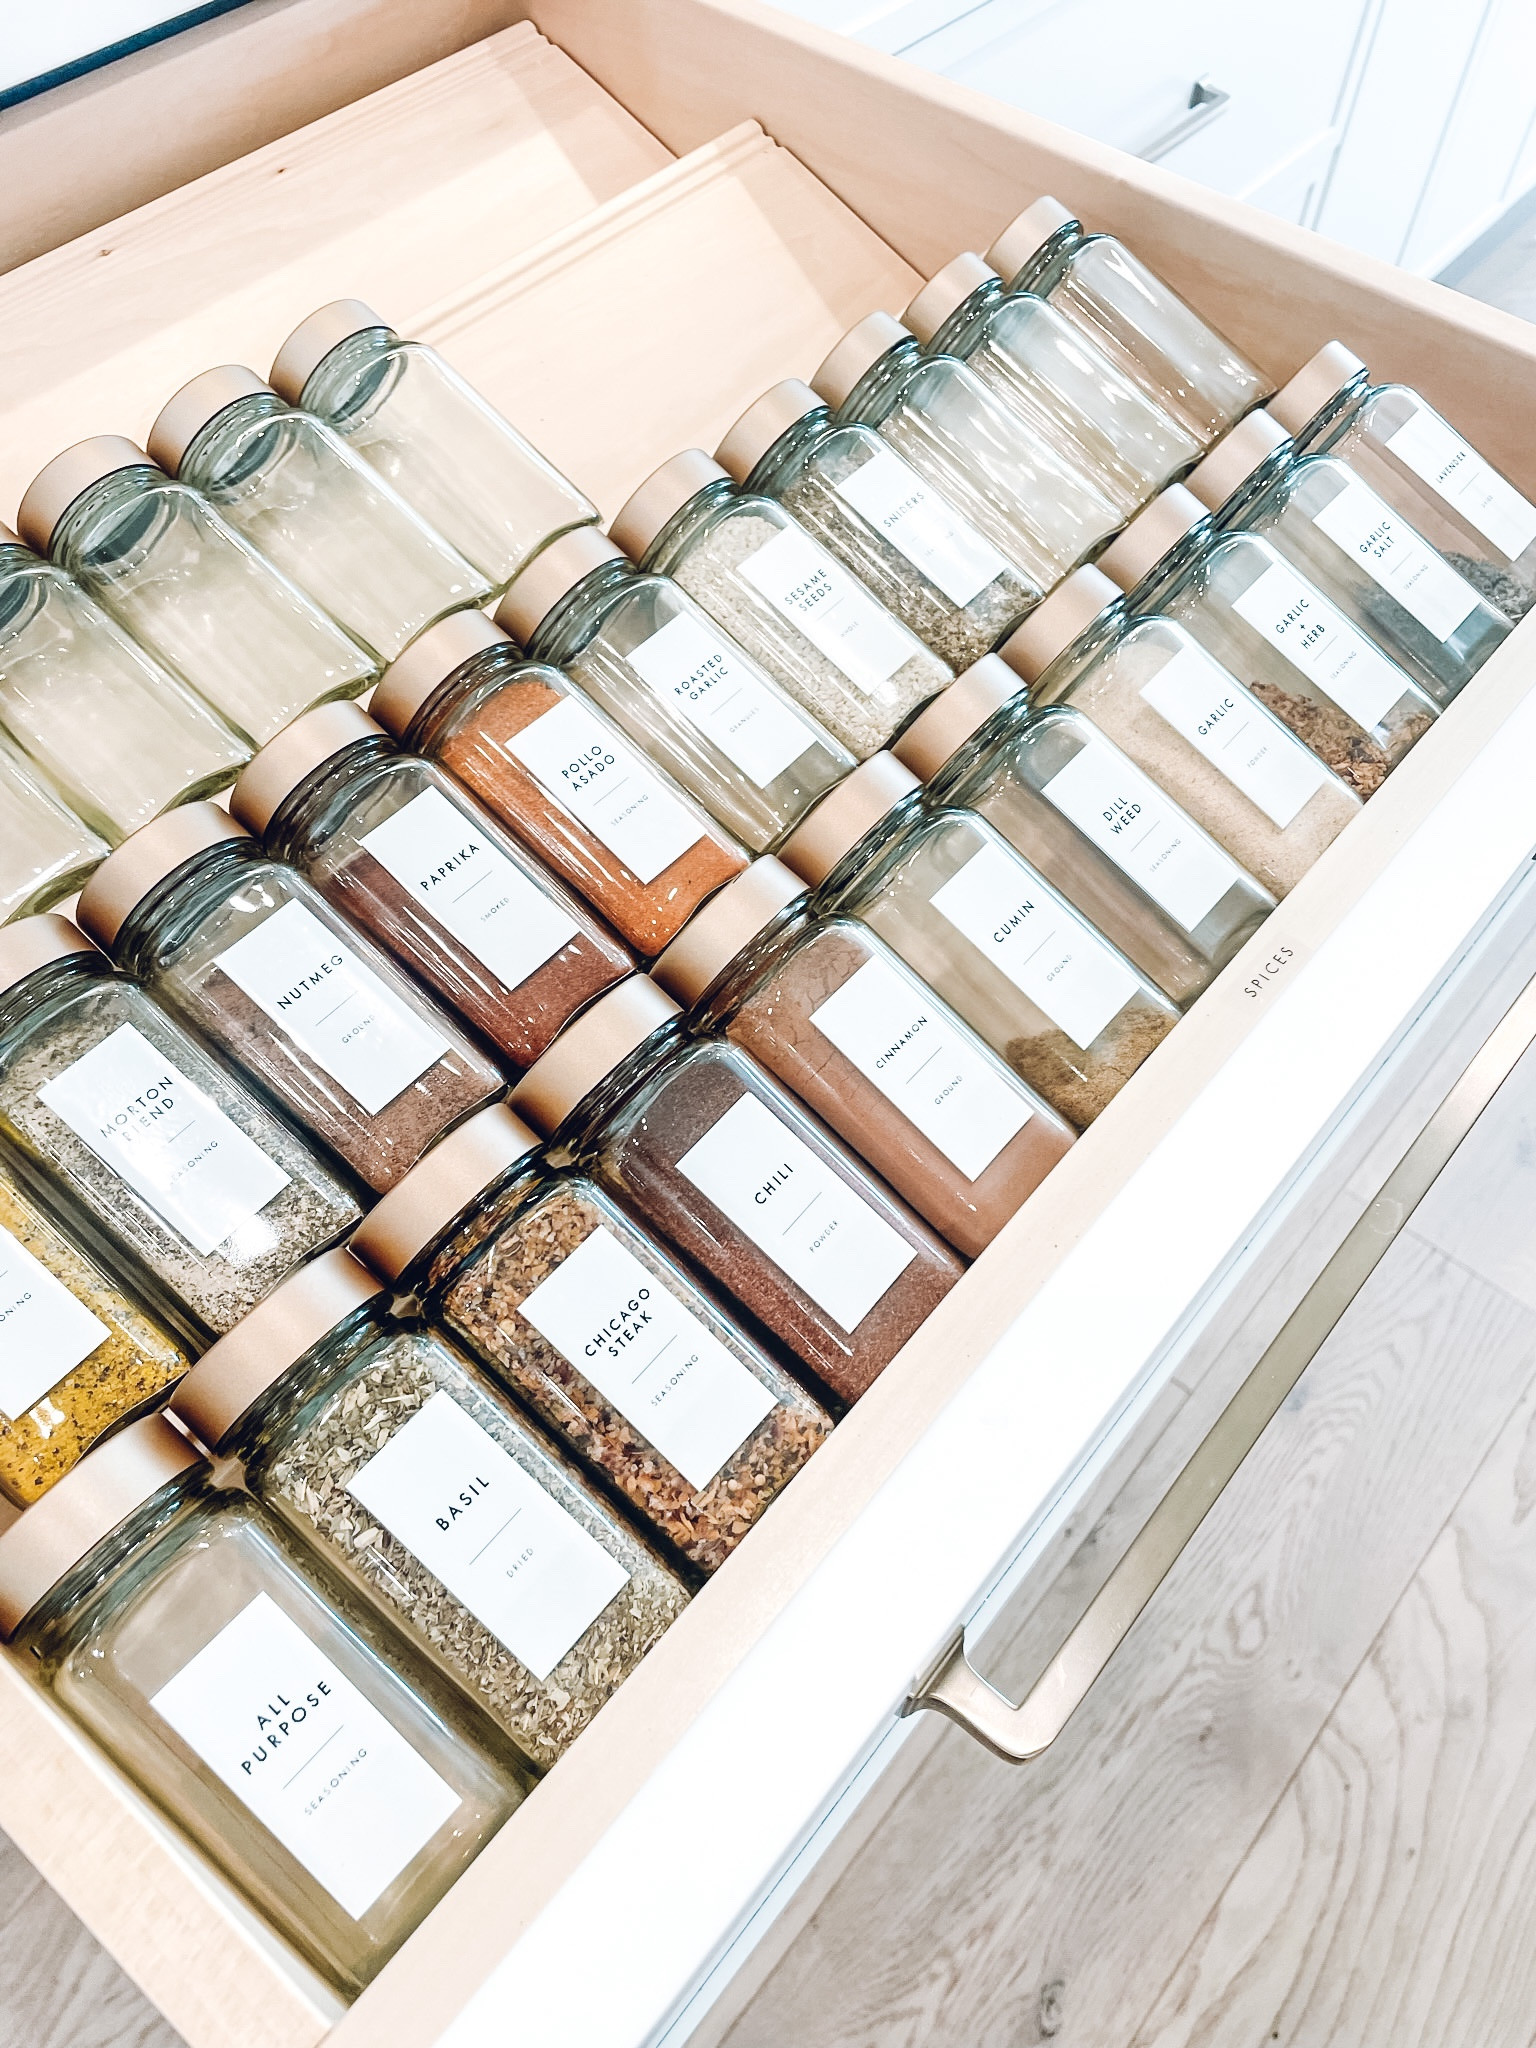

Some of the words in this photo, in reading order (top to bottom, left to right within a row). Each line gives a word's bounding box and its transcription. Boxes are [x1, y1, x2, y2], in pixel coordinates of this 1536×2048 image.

[1435, 451, 1467, 484] LAVENDER
[883, 491, 925, 528] SNIDERS
[1359, 521, 1391, 553] GARLIC
[1373, 535, 1395, 558] SALT
[784, 568, 828, 606] SESAME
[798, 582, 832, 612] SEEDS
[1275, 598, 1309, 634] GARLIC
[1300, 623, 1325, 650] HERB
[673, 653, 723, 696] ROASTED
[688, 666, 729, 701] GARLIC
[1198, 698, 1234, 736] GARLIC
[561, 745, 602, 779] POLLO
[571, 754, 615, 792] ASADO
[610, 793, 649, 826] SEASONING
[1102, 797, 1128, 822] DILL
[1110, 803, 1142, 835] WEED
[419, 843, 480, 891] PAPRIKA
[1149, 837, 1181, 873] SEASONING
[480, 896, 510, 922] SMOKED
[993, 900, 1035, 943] CUMIN
[276, 954, 343, 1010] NUTMEG
[1046, 954, 1073, 982] GROUND
[1244, 946, 1294, 998] SPICES
[341, 1013, 376, 1044] GROUND
[875, 1015, 928, 1069] CINNAMON
[100, 1075, 175, 1139] MORTON
[934, 1075, 963, 1105] GROUND
[754, 1162, 794, 1205] CHILI
[808, 1219, 838, 1253] POWDER
[584, 1288, 651, 1358] CHICAGO
[608, 1310, 652, 1358] STEAK
[650, 1353, 699, 1408] SEASONING
[435, 1476, 490, 1532] BASIL
[506, 1547, 534, 1579] DRIED
[240, 1680, 332, 1776] PURPOSE
[256, 1693, 290, 1731] ALL
[304, 1747, 367, 1817] SEASONING
